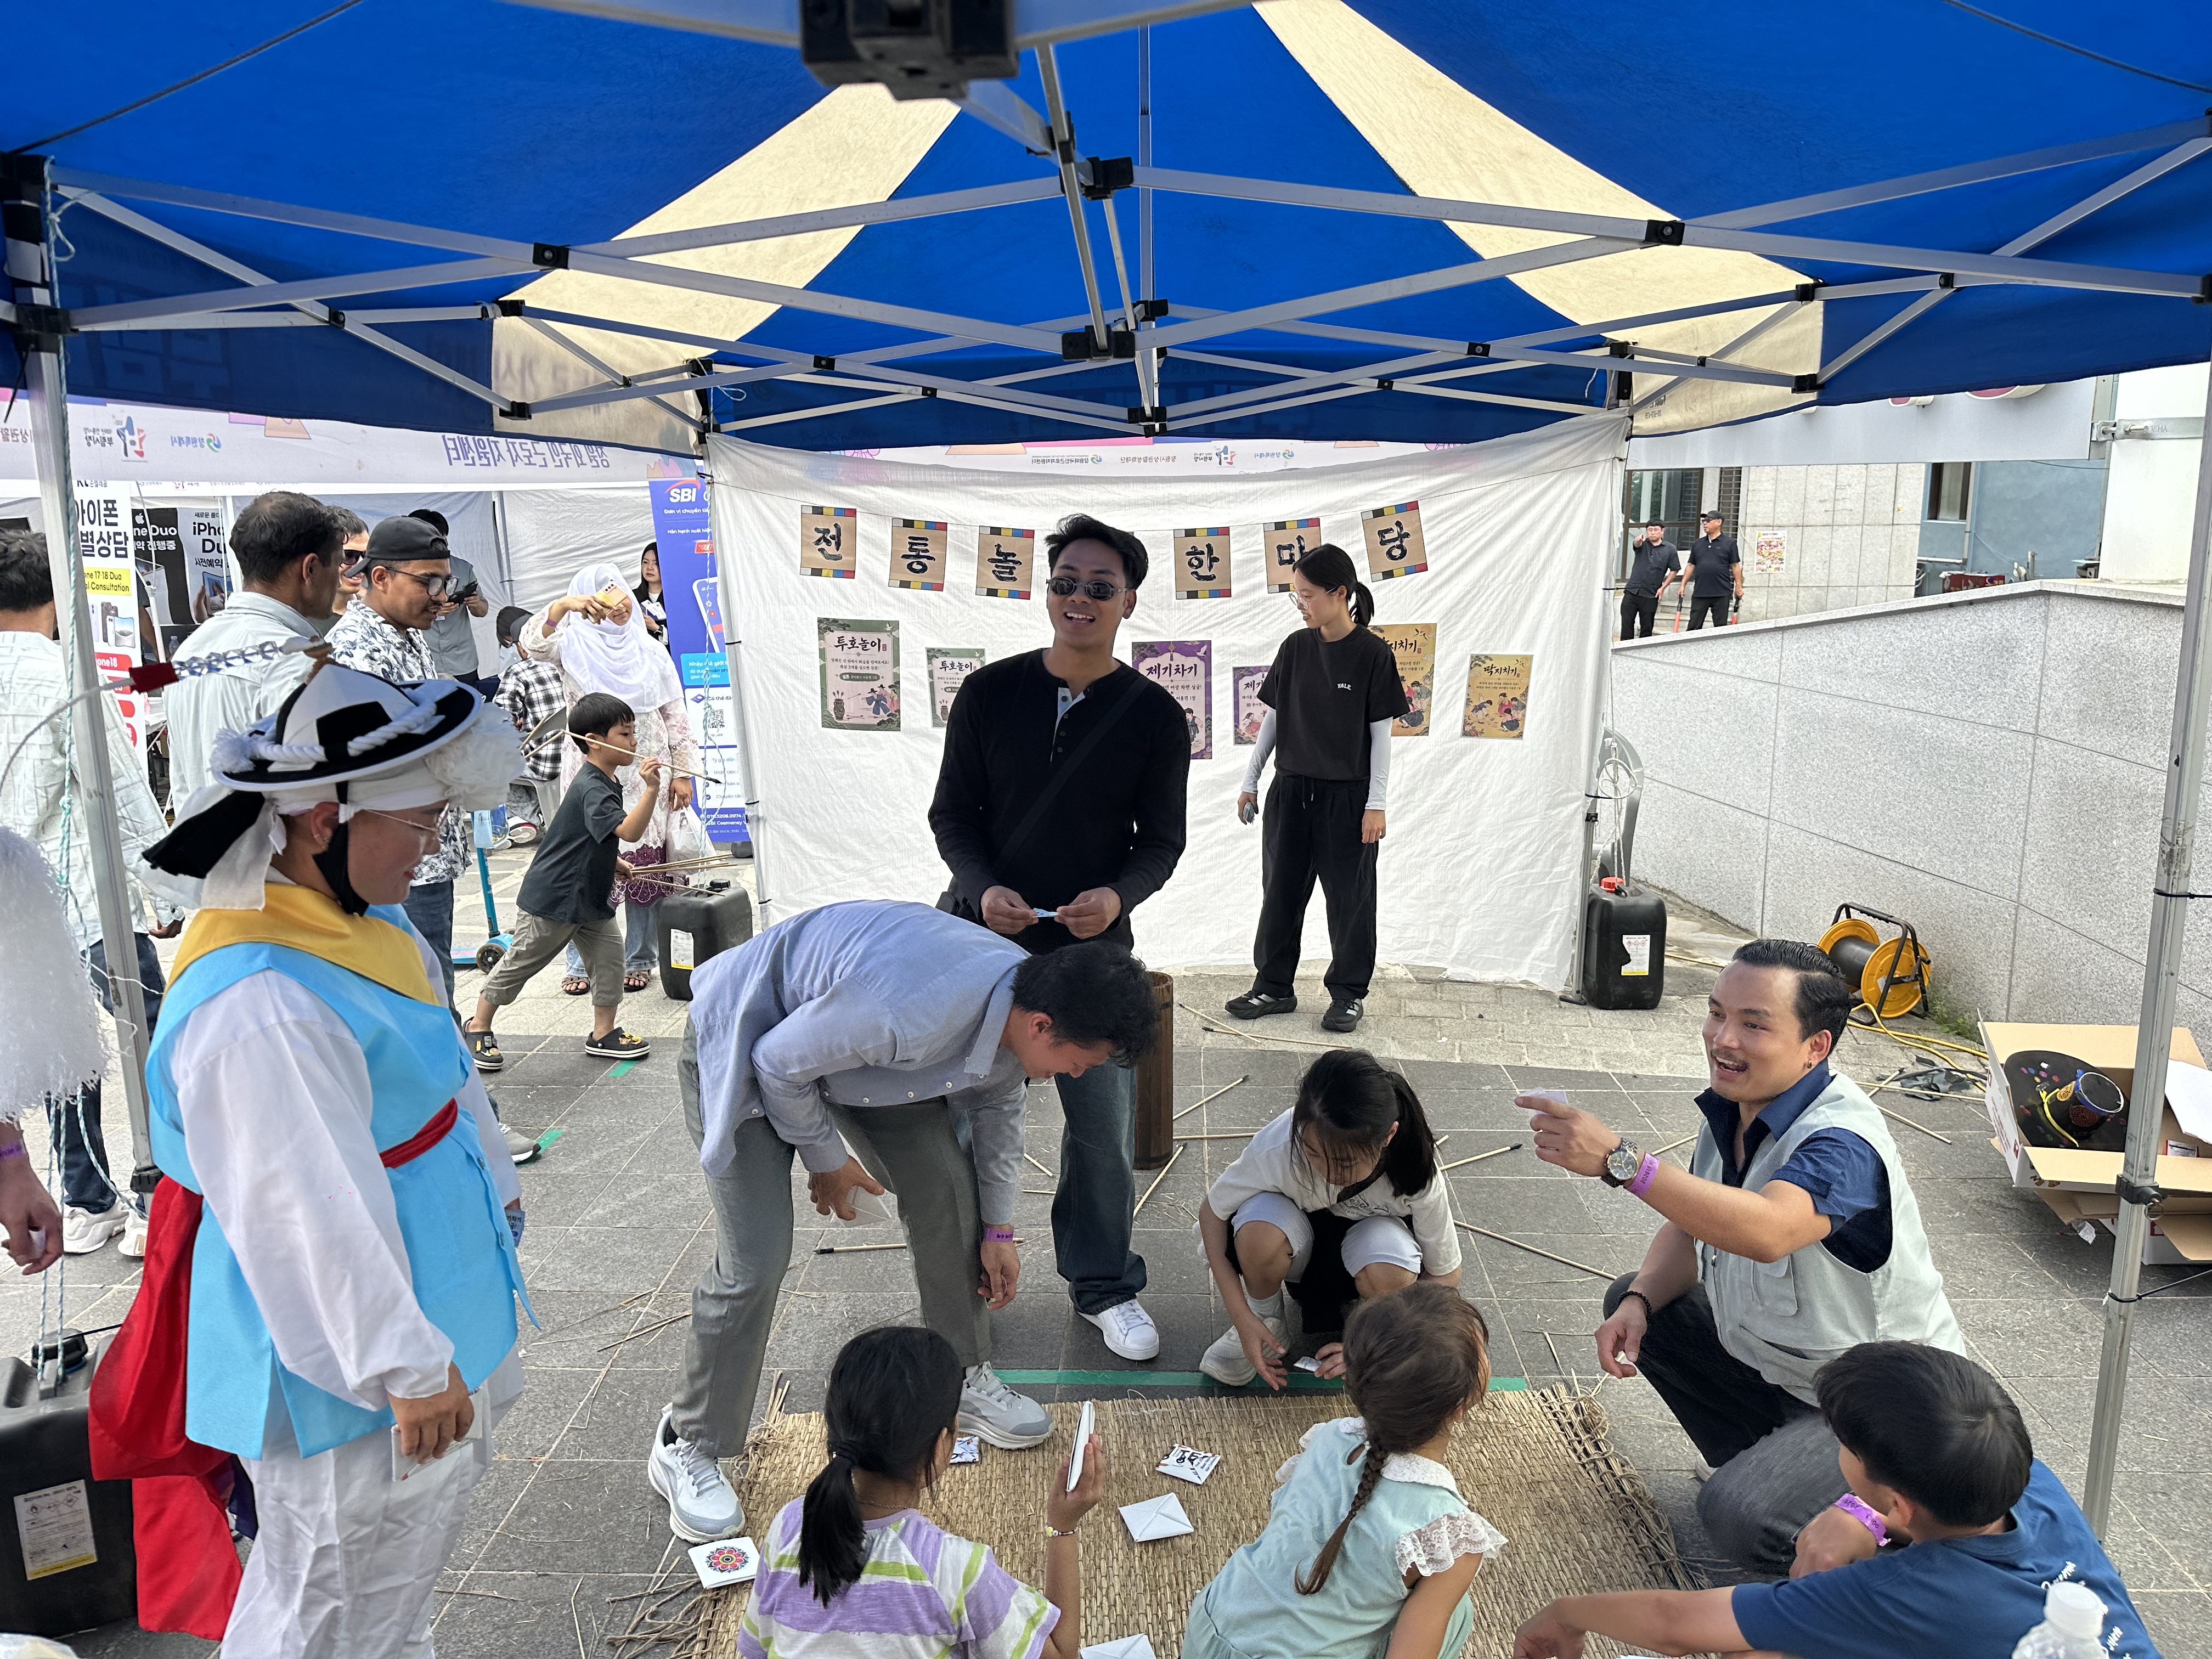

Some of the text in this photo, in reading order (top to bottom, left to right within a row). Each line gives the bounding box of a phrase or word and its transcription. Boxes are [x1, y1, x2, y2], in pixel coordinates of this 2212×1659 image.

[669, 488, 696, 503] SBI
[150, 524, 177, 536] Duo
[134, 540, 145, 551] 약
[814, 523, 843, 561] 전
[900, 536, 935, 574] 통
[988, 544, 1022, 582] 놀
[1185, 544, 1219, 581] 한
[1378, 520, 1410, 561] 당
[91, 582, 129, 591] Consultation
[834, 635, 881, 652] 투호놀이
[939, 660, 972, 672] 투호놀이
[1146, 663, 1198, 680] 제기차기
[1483, 664, 1517, 676] 딱지치기
